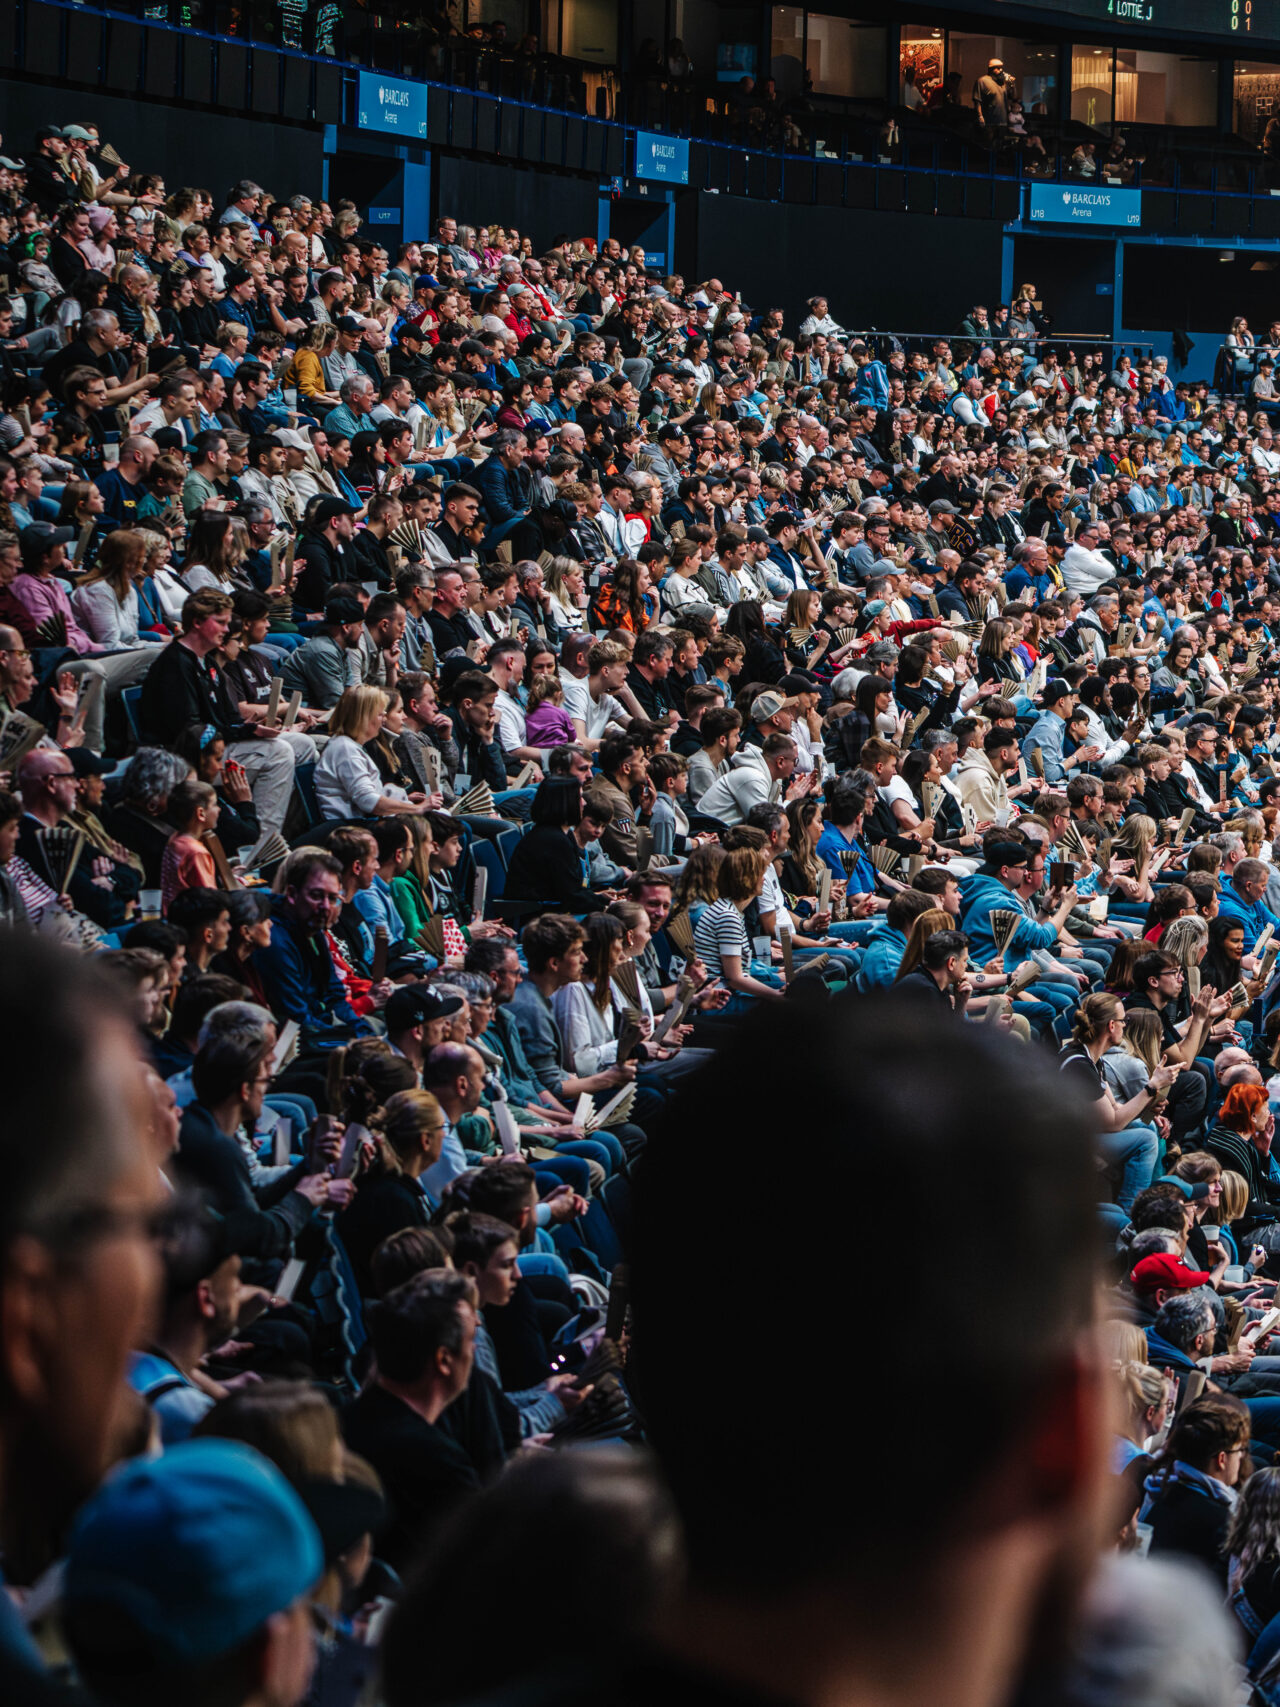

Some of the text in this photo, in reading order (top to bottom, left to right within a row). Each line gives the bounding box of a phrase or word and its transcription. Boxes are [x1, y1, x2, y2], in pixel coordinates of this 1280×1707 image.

[1232, 0, 1252, 14] 0 0
[1107, 0, 1114, 14] 4
[1146, 6, 1153, 20] J
[1231, 16, 1238, 30] 0
[1245, 17, 1251, 30] 1
[385, 88, 409, 107] BARCLAYS
[1072, 193, 1111, 206] BARCLAYS
[1031, 209, 1045, 218] U18
[1072, 207, 1092, 217] Arena
[1127, 215, 1140, 224] U19
